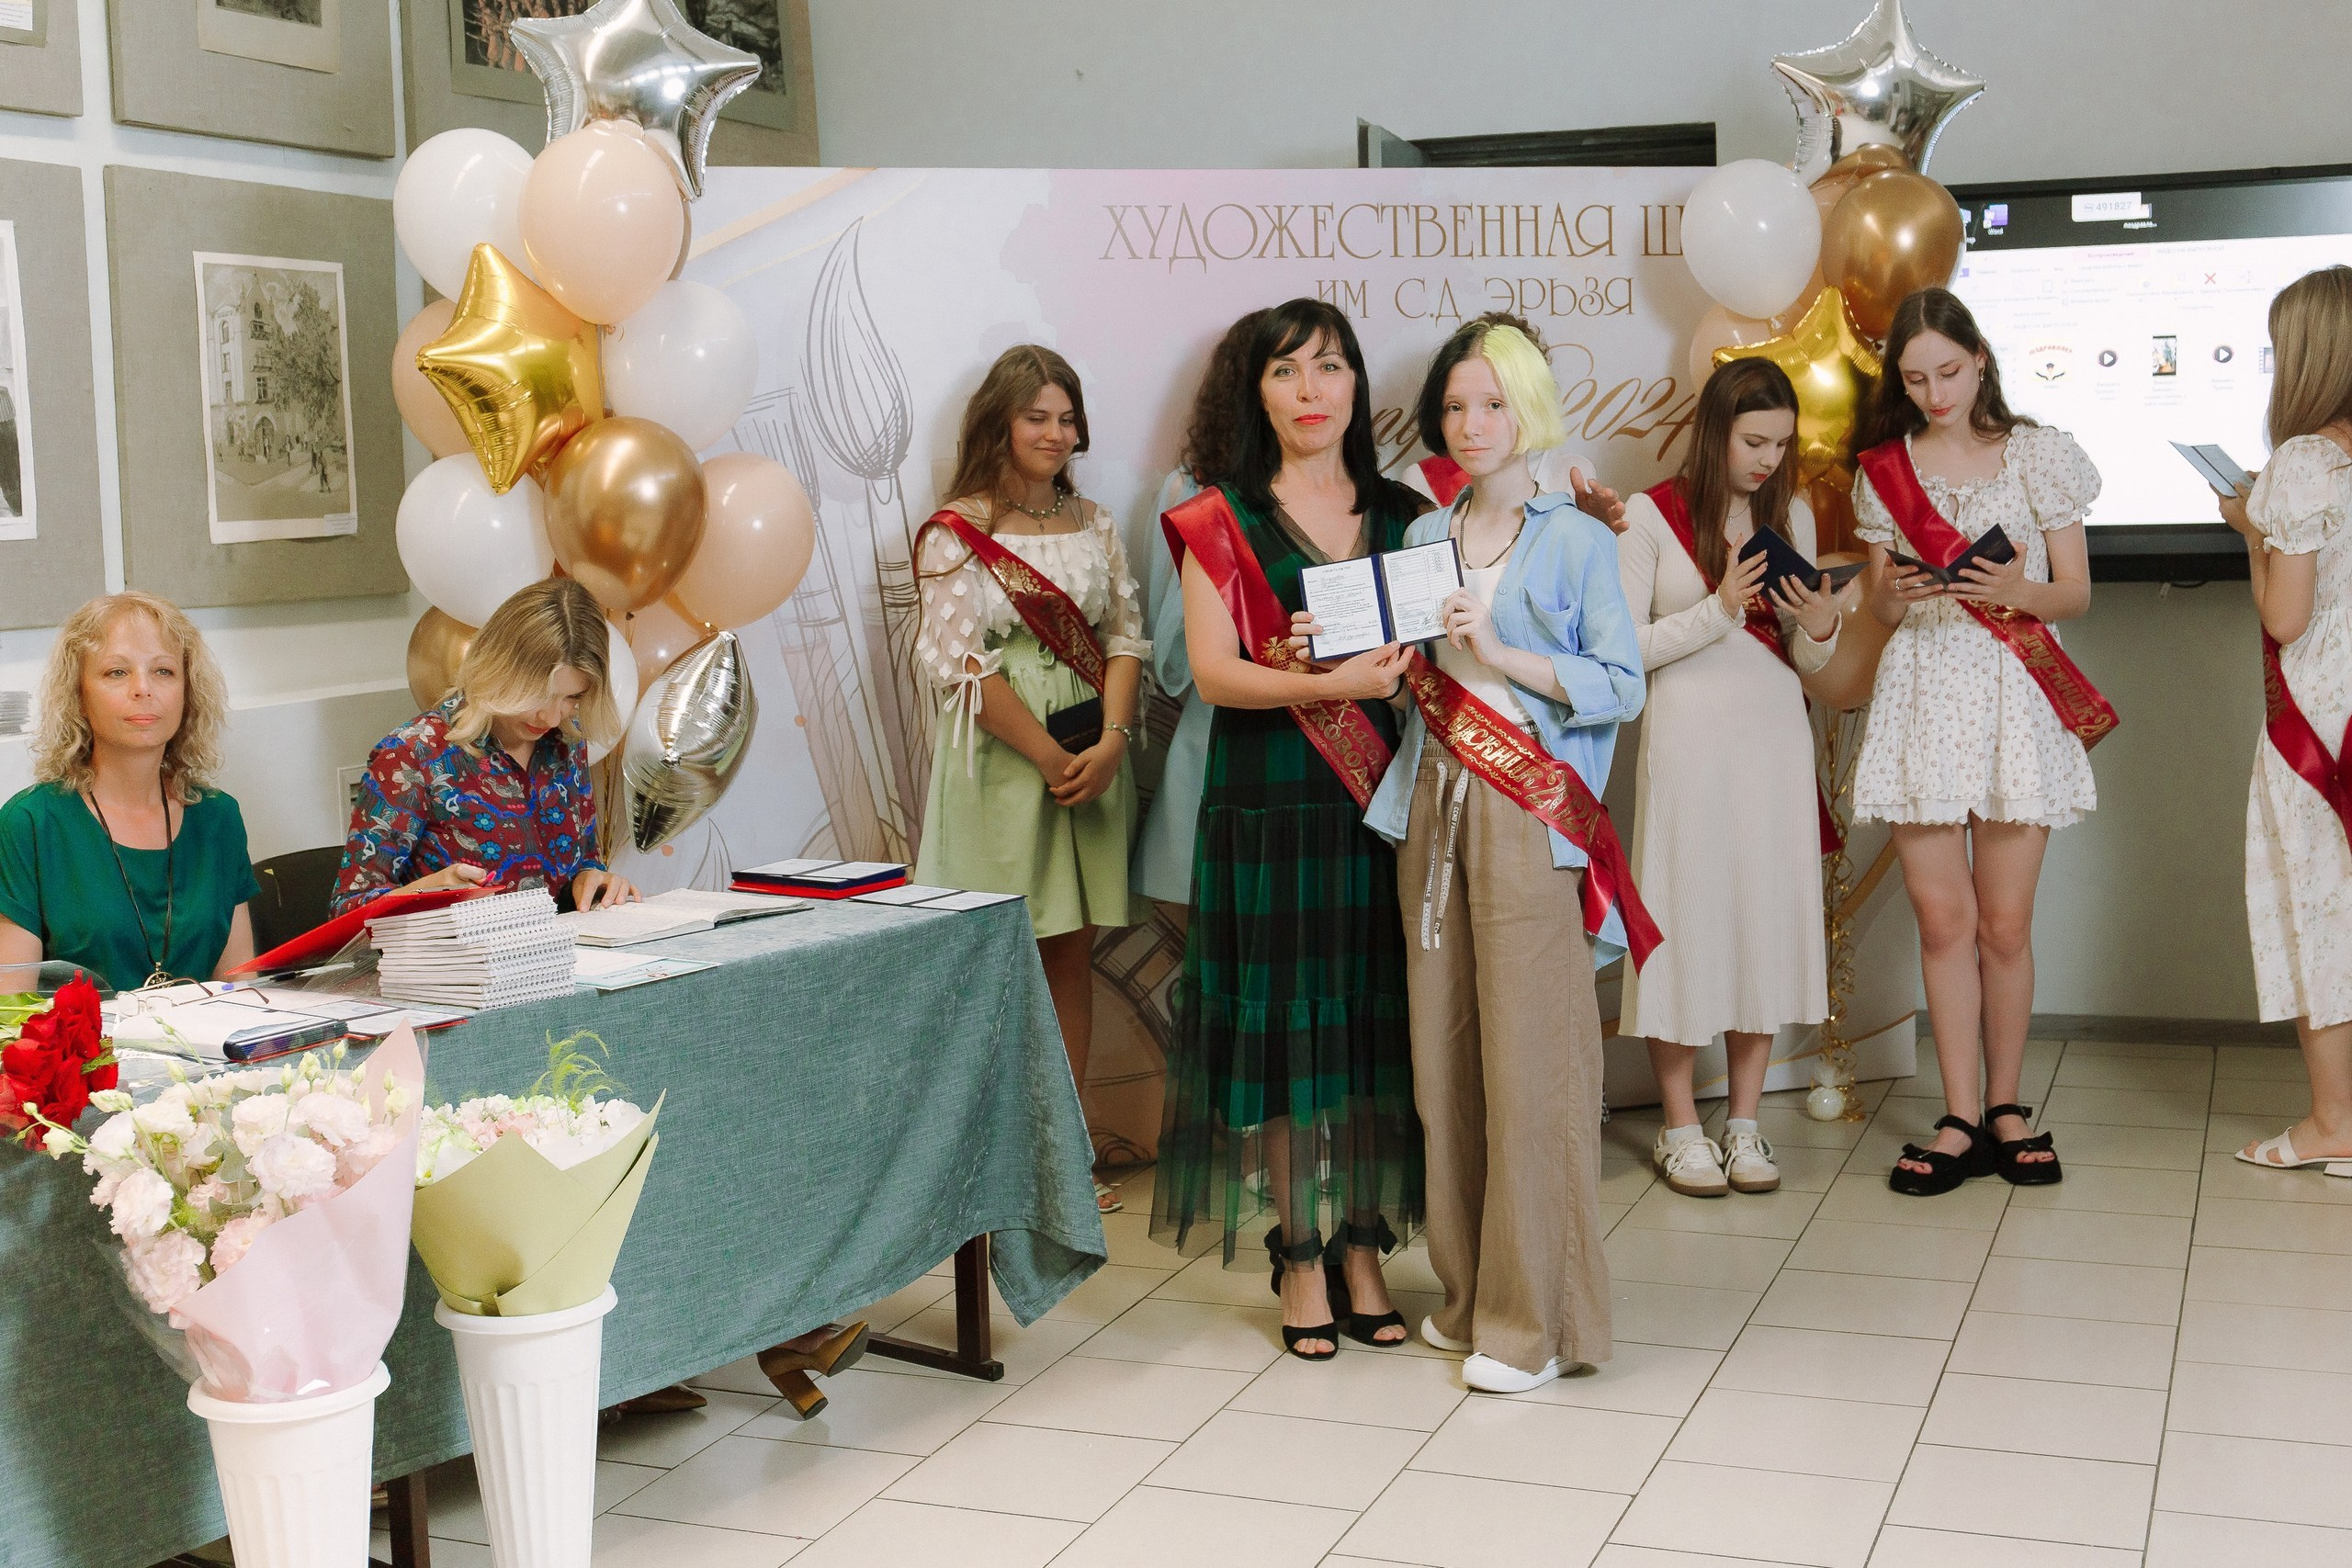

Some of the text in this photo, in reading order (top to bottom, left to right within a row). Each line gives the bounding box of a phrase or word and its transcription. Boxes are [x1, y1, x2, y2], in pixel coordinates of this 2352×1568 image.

[2096, 202, 2132, 210] 491827
[1098, 202, 1618, 274] ХУДОЖЕСТВЕННАЯ
[1315, 279, 1368, 319] ИМ
[1485, 276, 1634, 316] ЭРЬЗЯ
[1560, 377, 1697, 461] 2024
